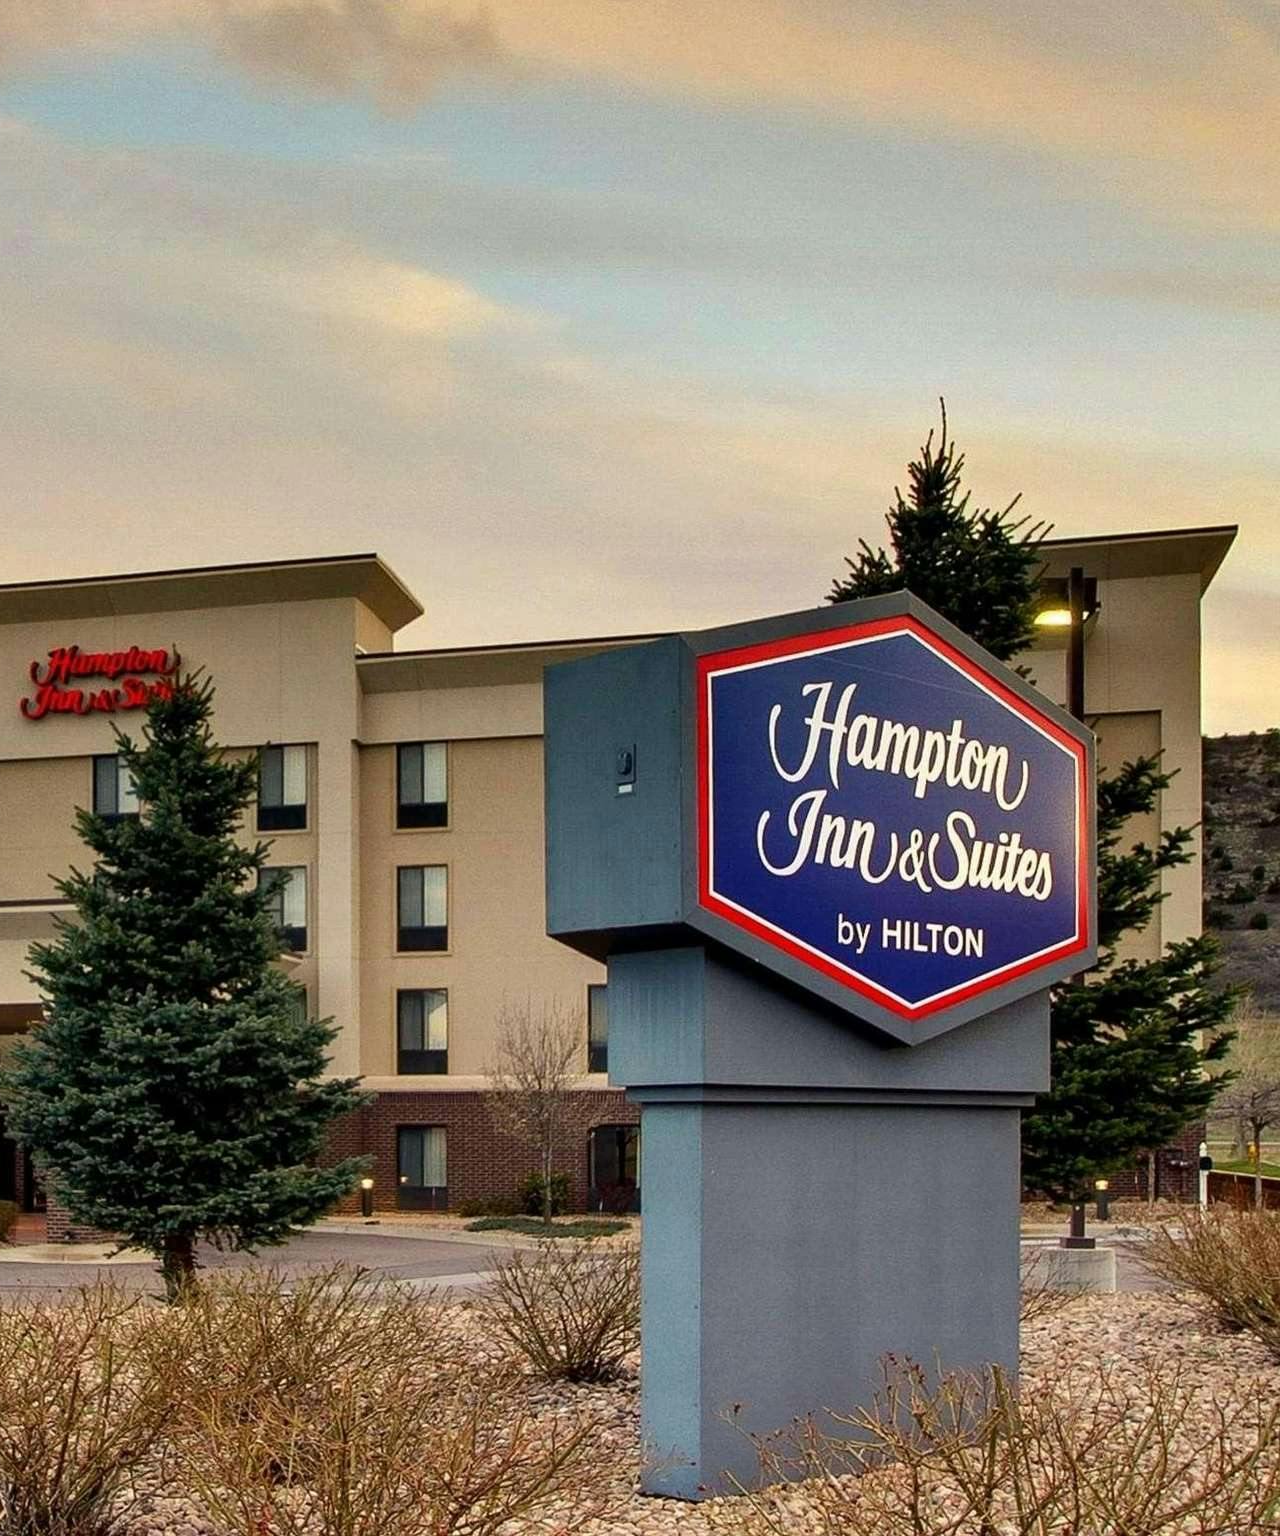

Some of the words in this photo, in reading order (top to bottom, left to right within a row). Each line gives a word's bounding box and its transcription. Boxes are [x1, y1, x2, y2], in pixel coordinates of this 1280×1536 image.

[30, 645, 180, 686] Hampton
[21, 683, 90, 720] Inn
[768, 681, 1030, 811] Hampton
[756, 789, 898, 884] Inn
[898, 829, 933, 893] &
[928, 811, 1053, 901] Suites
[837, 913, 871, 954] by
[881, 918, 984, 958] HILTON
